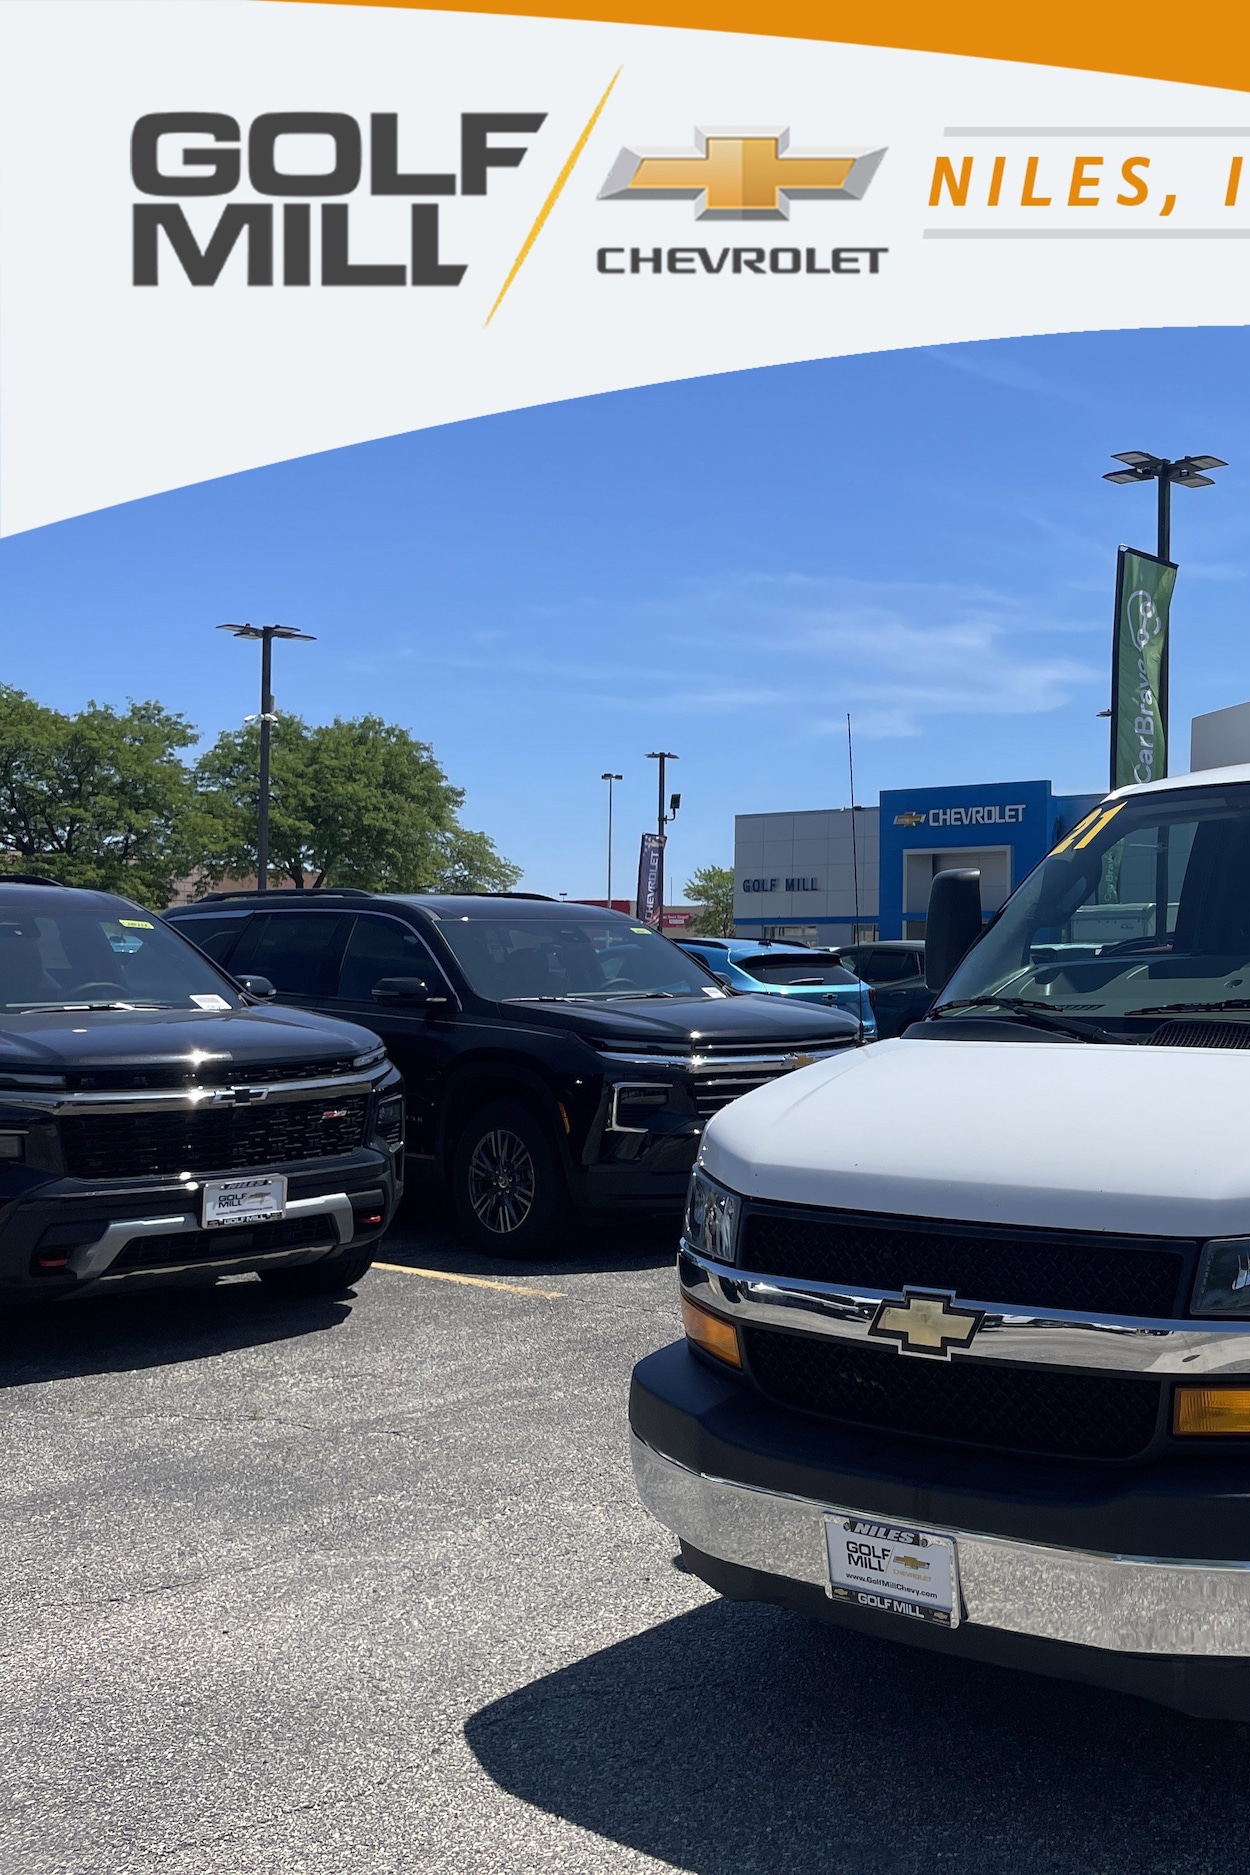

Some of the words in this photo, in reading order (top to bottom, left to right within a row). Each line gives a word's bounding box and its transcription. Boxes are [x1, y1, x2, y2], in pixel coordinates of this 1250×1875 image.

[1133, 657, 1155, 783] CarBravo
[929, 804, 1027, 827] CHEVROLET
[1047, 801, 1129, 858] 21
[645, 851, 659, 921] CHEVROLET
[742, 877, 777, 893] GOLF
[785, 877, 818, 892] MILL
[218, 1192, 248, 1202] GOLF
[218, 1199, 242, 1208] MILL
[223, 1216, 245, 1225] GOLF
[246, 1213, 267, 1222] MILL
[855, 1522, 915, 1544] NILES
[845, 1540, 891, 1560] GOLF
[848, 1553, 885, 1572] MILL
[845, 1572, 938, 1599] www.GolfMillChevy.com
[857, 1593, 892, 1610] GOLF
[893, 1600, 925, 1619] MILL
